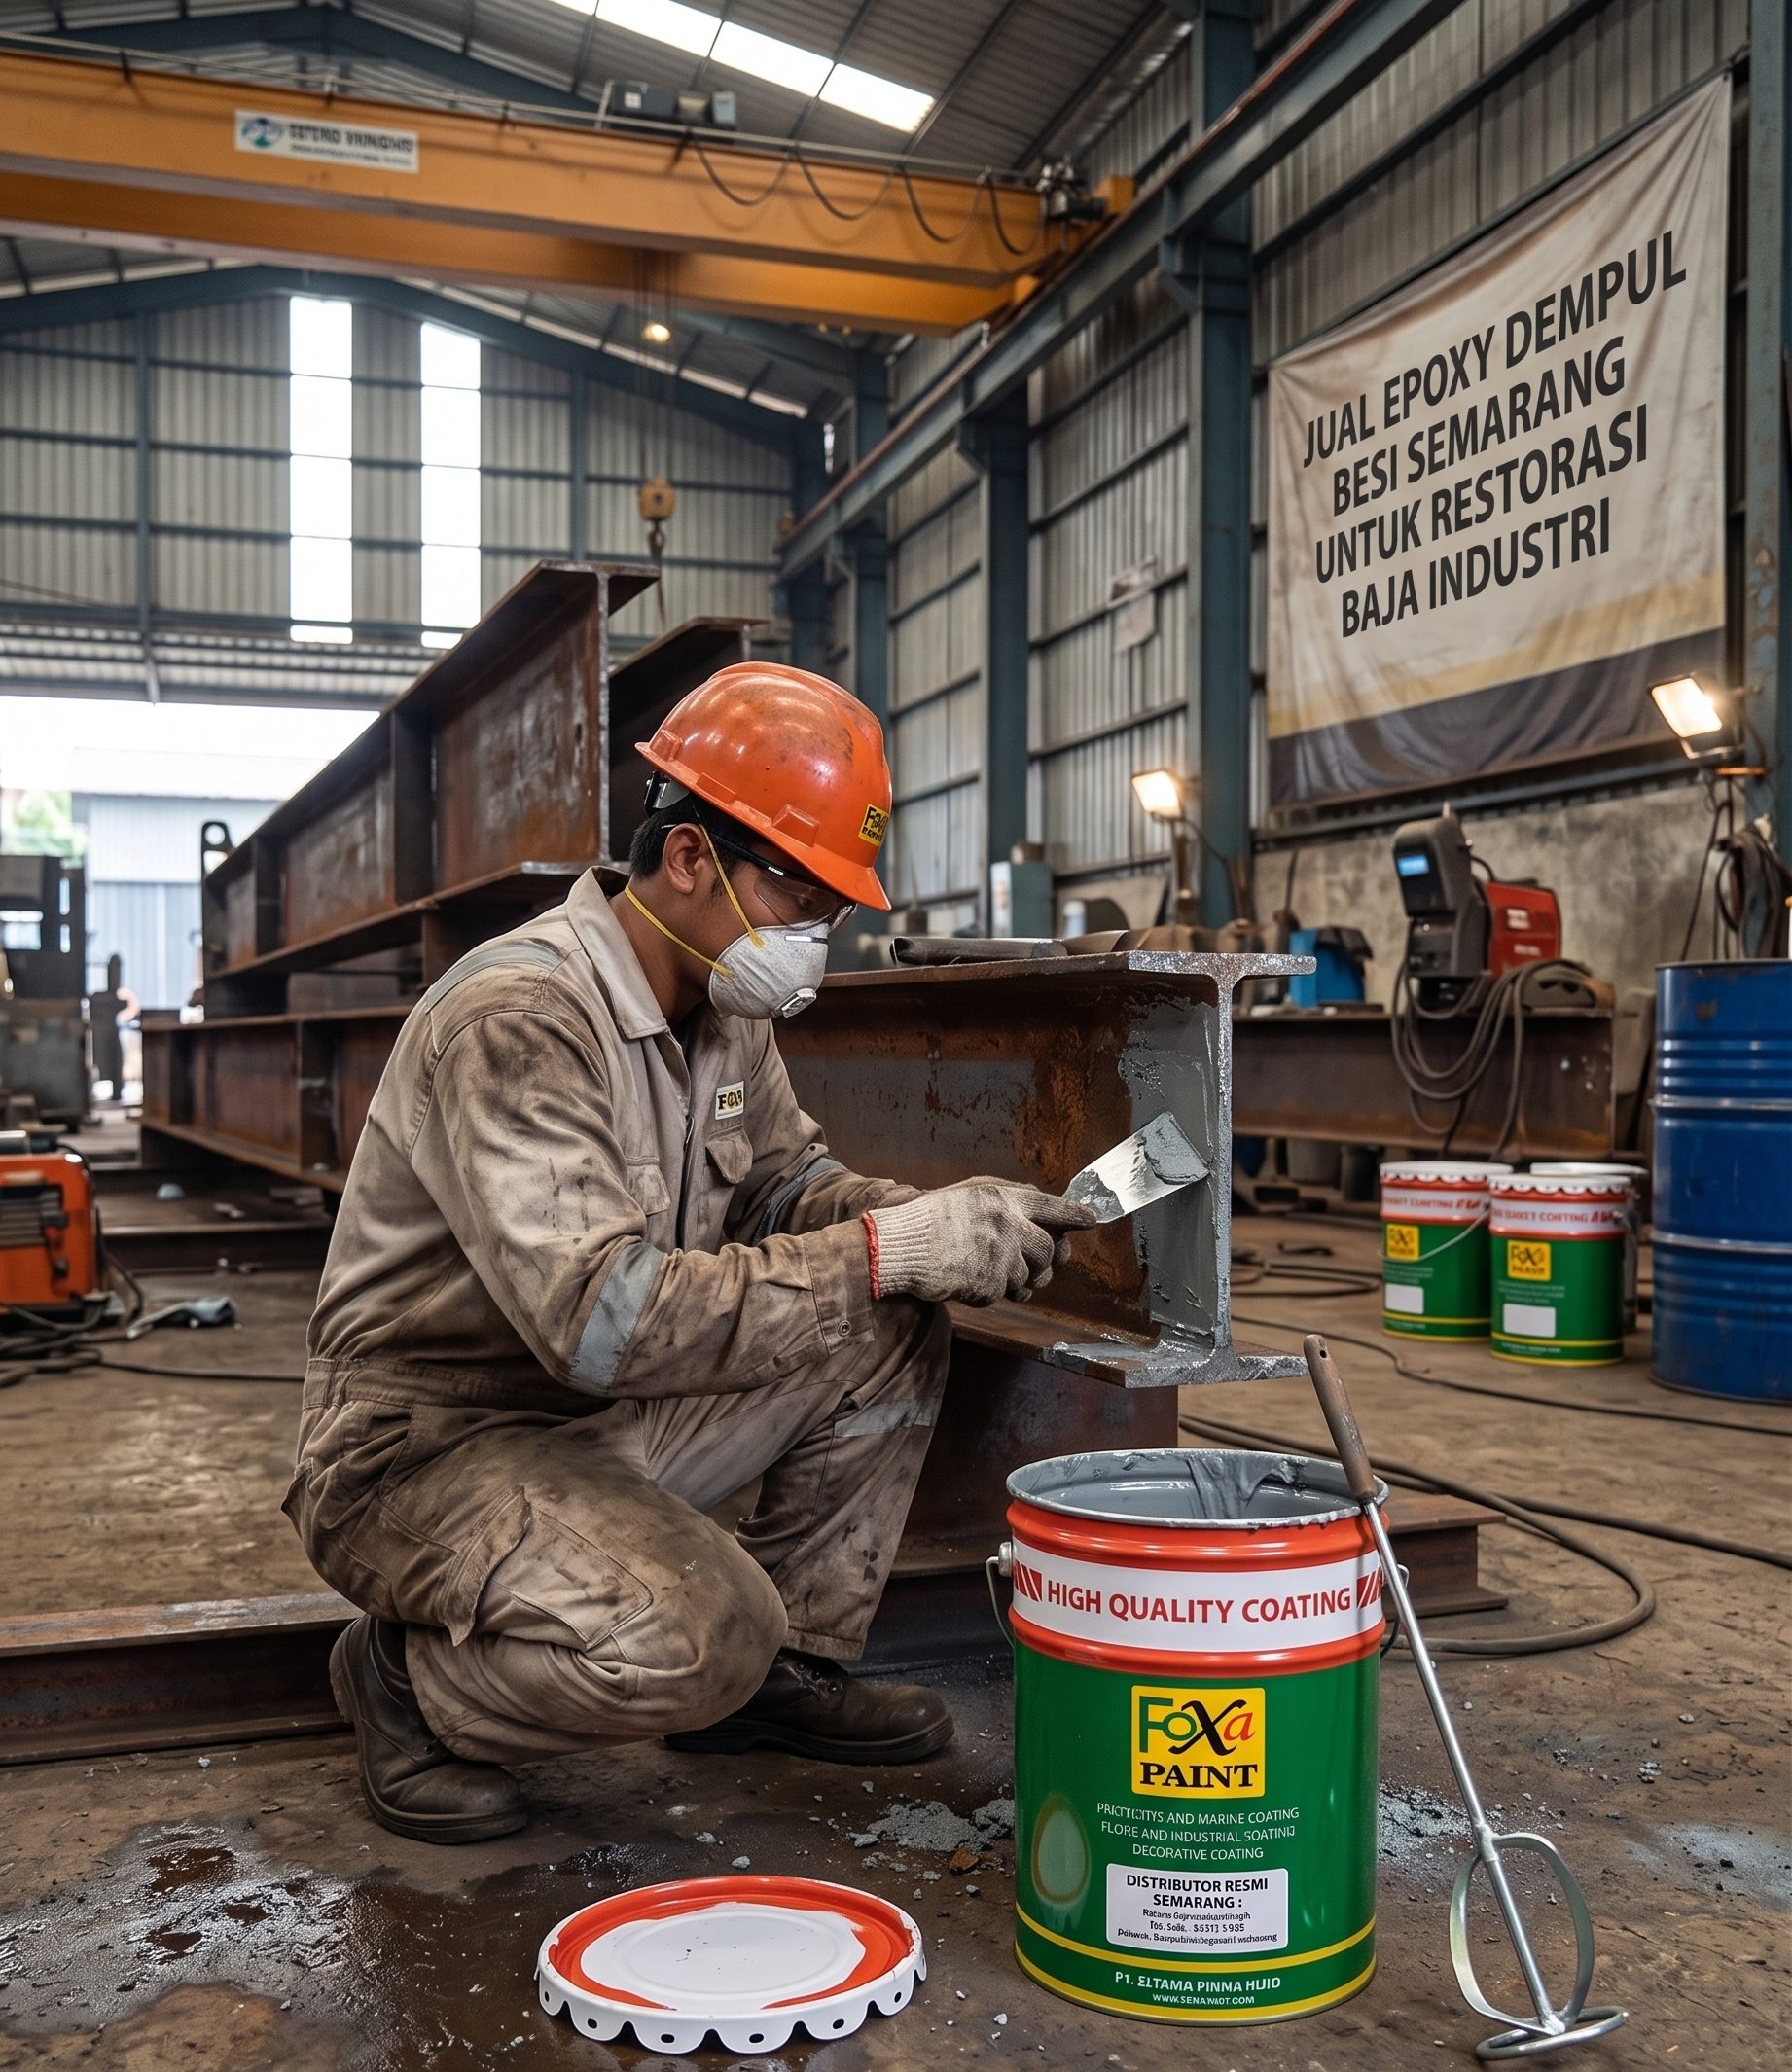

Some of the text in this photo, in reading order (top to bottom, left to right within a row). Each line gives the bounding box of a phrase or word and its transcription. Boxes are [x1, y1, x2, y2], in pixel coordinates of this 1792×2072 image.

[1303, 230, 1687, 468] JUAL EPOXY DEMPUL
[1333, 336, 1626, 517] BESI SEMARANG
[1315, 403, 1648, 584] UNTUK RESTORASI
[1342, 497, 1610, 638] BAJA INDUSTRI
[1047, 1580, 1351, 1623] HIGH QUALITY COATING
[1139, 1761, 1258, 1788] PAINT
[1166, 1812, 1195, 1825] AND
[1198, 1812, 1245, 1825] MARINE
[1247, 1806, 1300, 1824] COATING
[1101, 1820, 1138, 1838] FLORE
[1141, 1828, 1167, 1841] AND
[1170, 1830, 1242, 1843] INDUSTRIAL
[1132, 1843, 1264, 1860] DECORATIVE COATING
[1127, 1874, 1269, 1892] DISTRIBUTOR RESMI
[1153, 1893, 1235, 1909] SEMARANG
